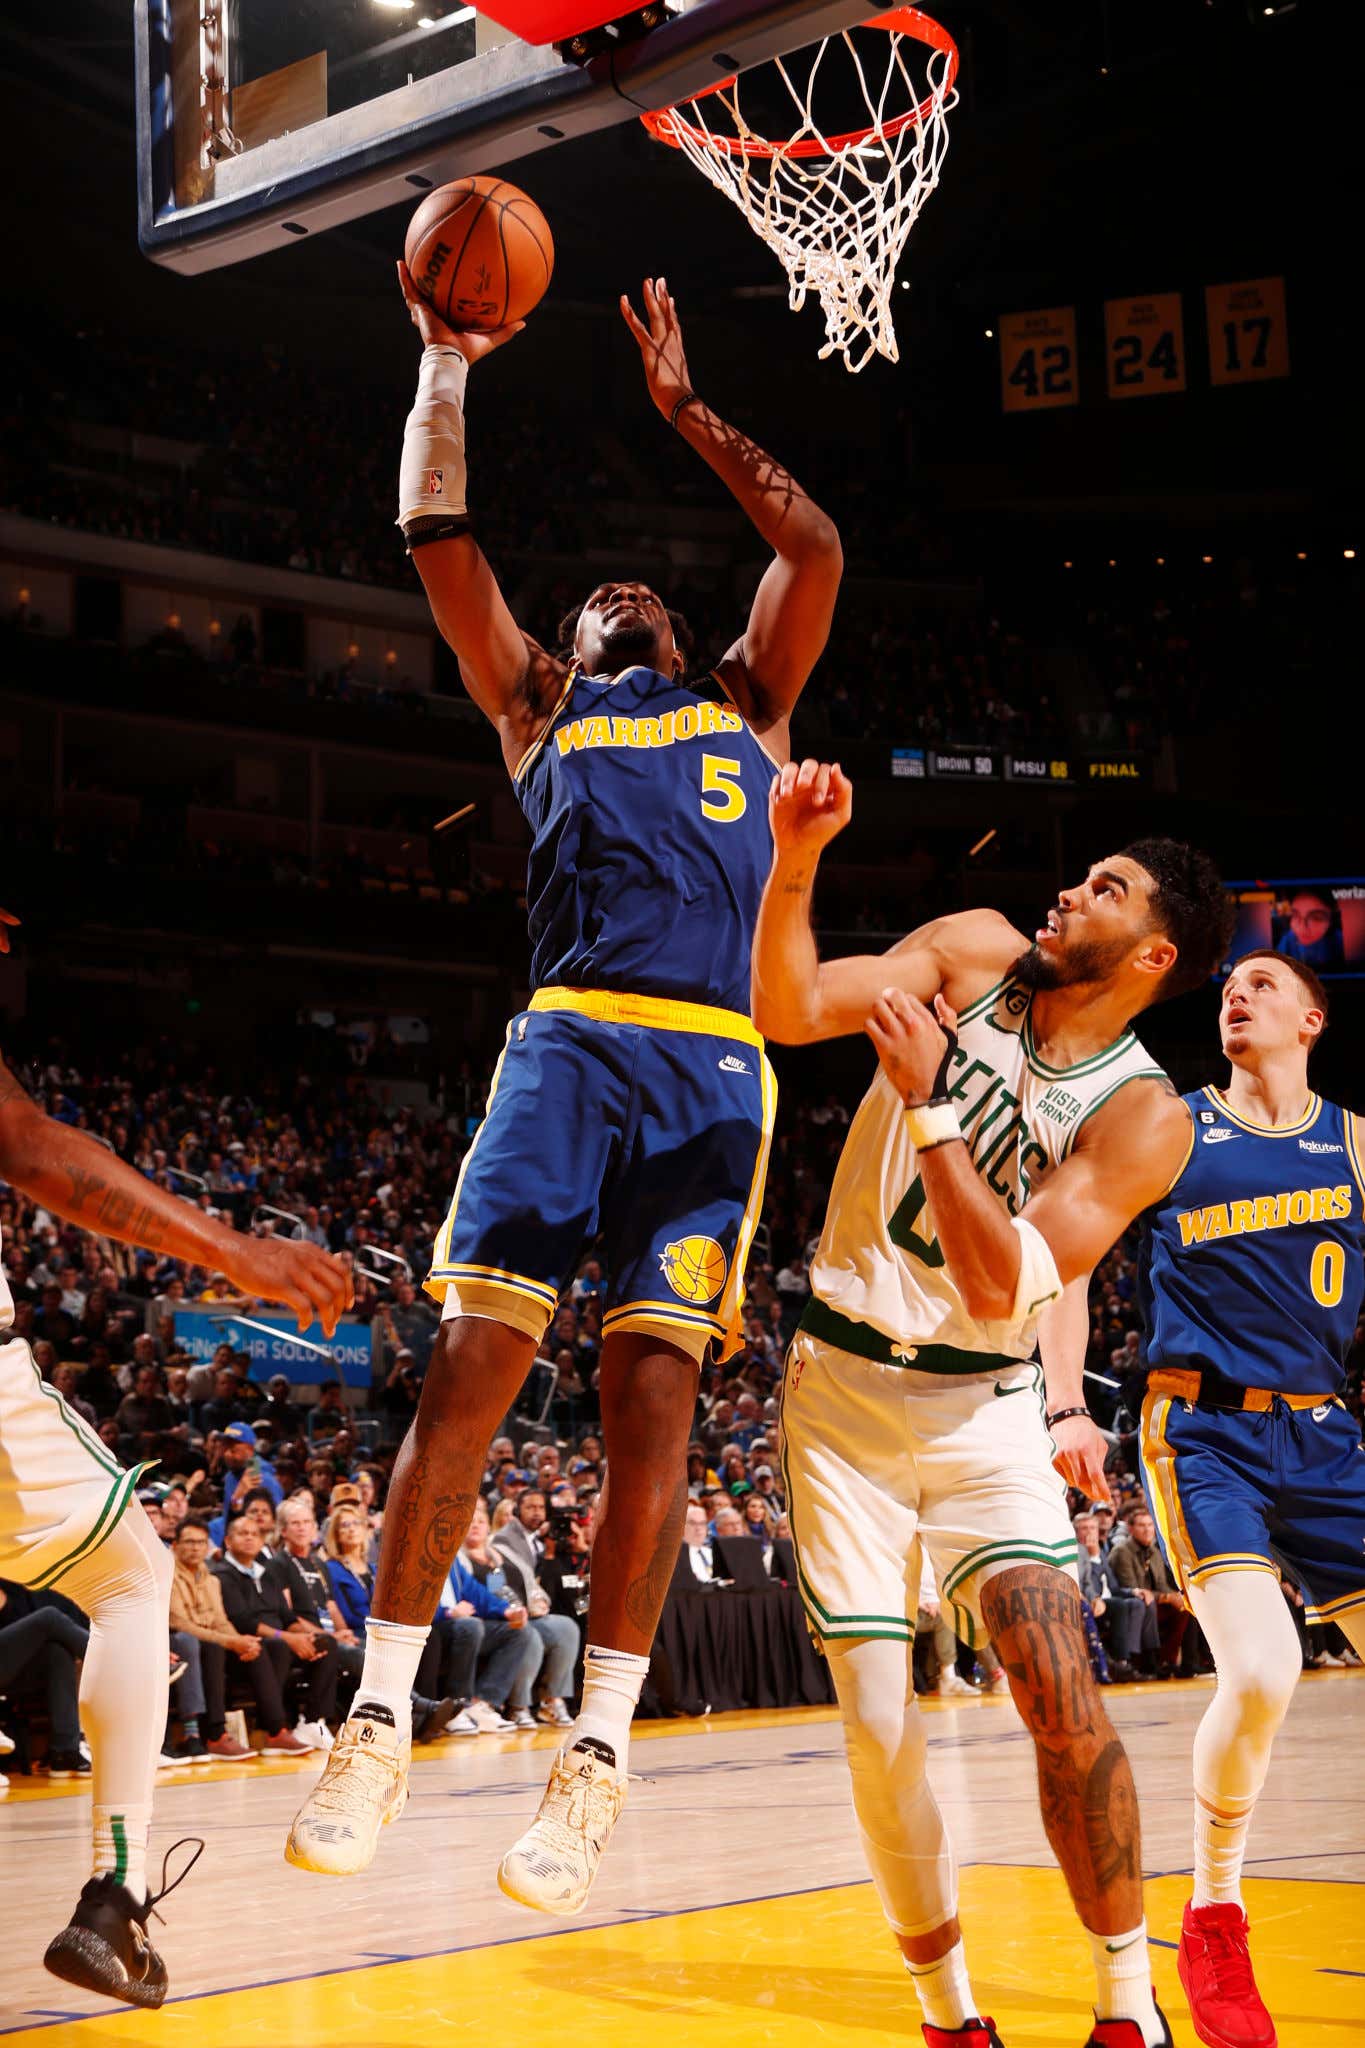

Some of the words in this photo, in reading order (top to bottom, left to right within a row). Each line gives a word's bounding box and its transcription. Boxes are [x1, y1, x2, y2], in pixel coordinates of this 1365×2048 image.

[1112, 330, 1179, 386] 24
[1222, 316, 1273, 373] 17
[1008, 344, 1073, 398] 42
[554, 701, 743, 757] WARRIORS
[936, 756, 971, 772] BROWN
[974, 756, 993, 775] 50
[1013, 760, 1047, 776] MSU
[1089, 763, 1140, 778] FINAL
[700, 753, 747, 823] 5
[724, 1055, 747, 1070] NIKE
[1035, 1099, 1074, 1128] PRINT
[1043, 1086, 1083, 1117] VISTA
[1200, 1112, 1216, 1124] 6
[1207, 1127, 1233, 1139] NIKE
[1299, 1139, 1344, 1153] Rakuten
[1177, 1185, 1352, 1247] WARRIORS
[1310, 1241, 1345, 1308] 0
[242, 1339, 268, 1359] HR
